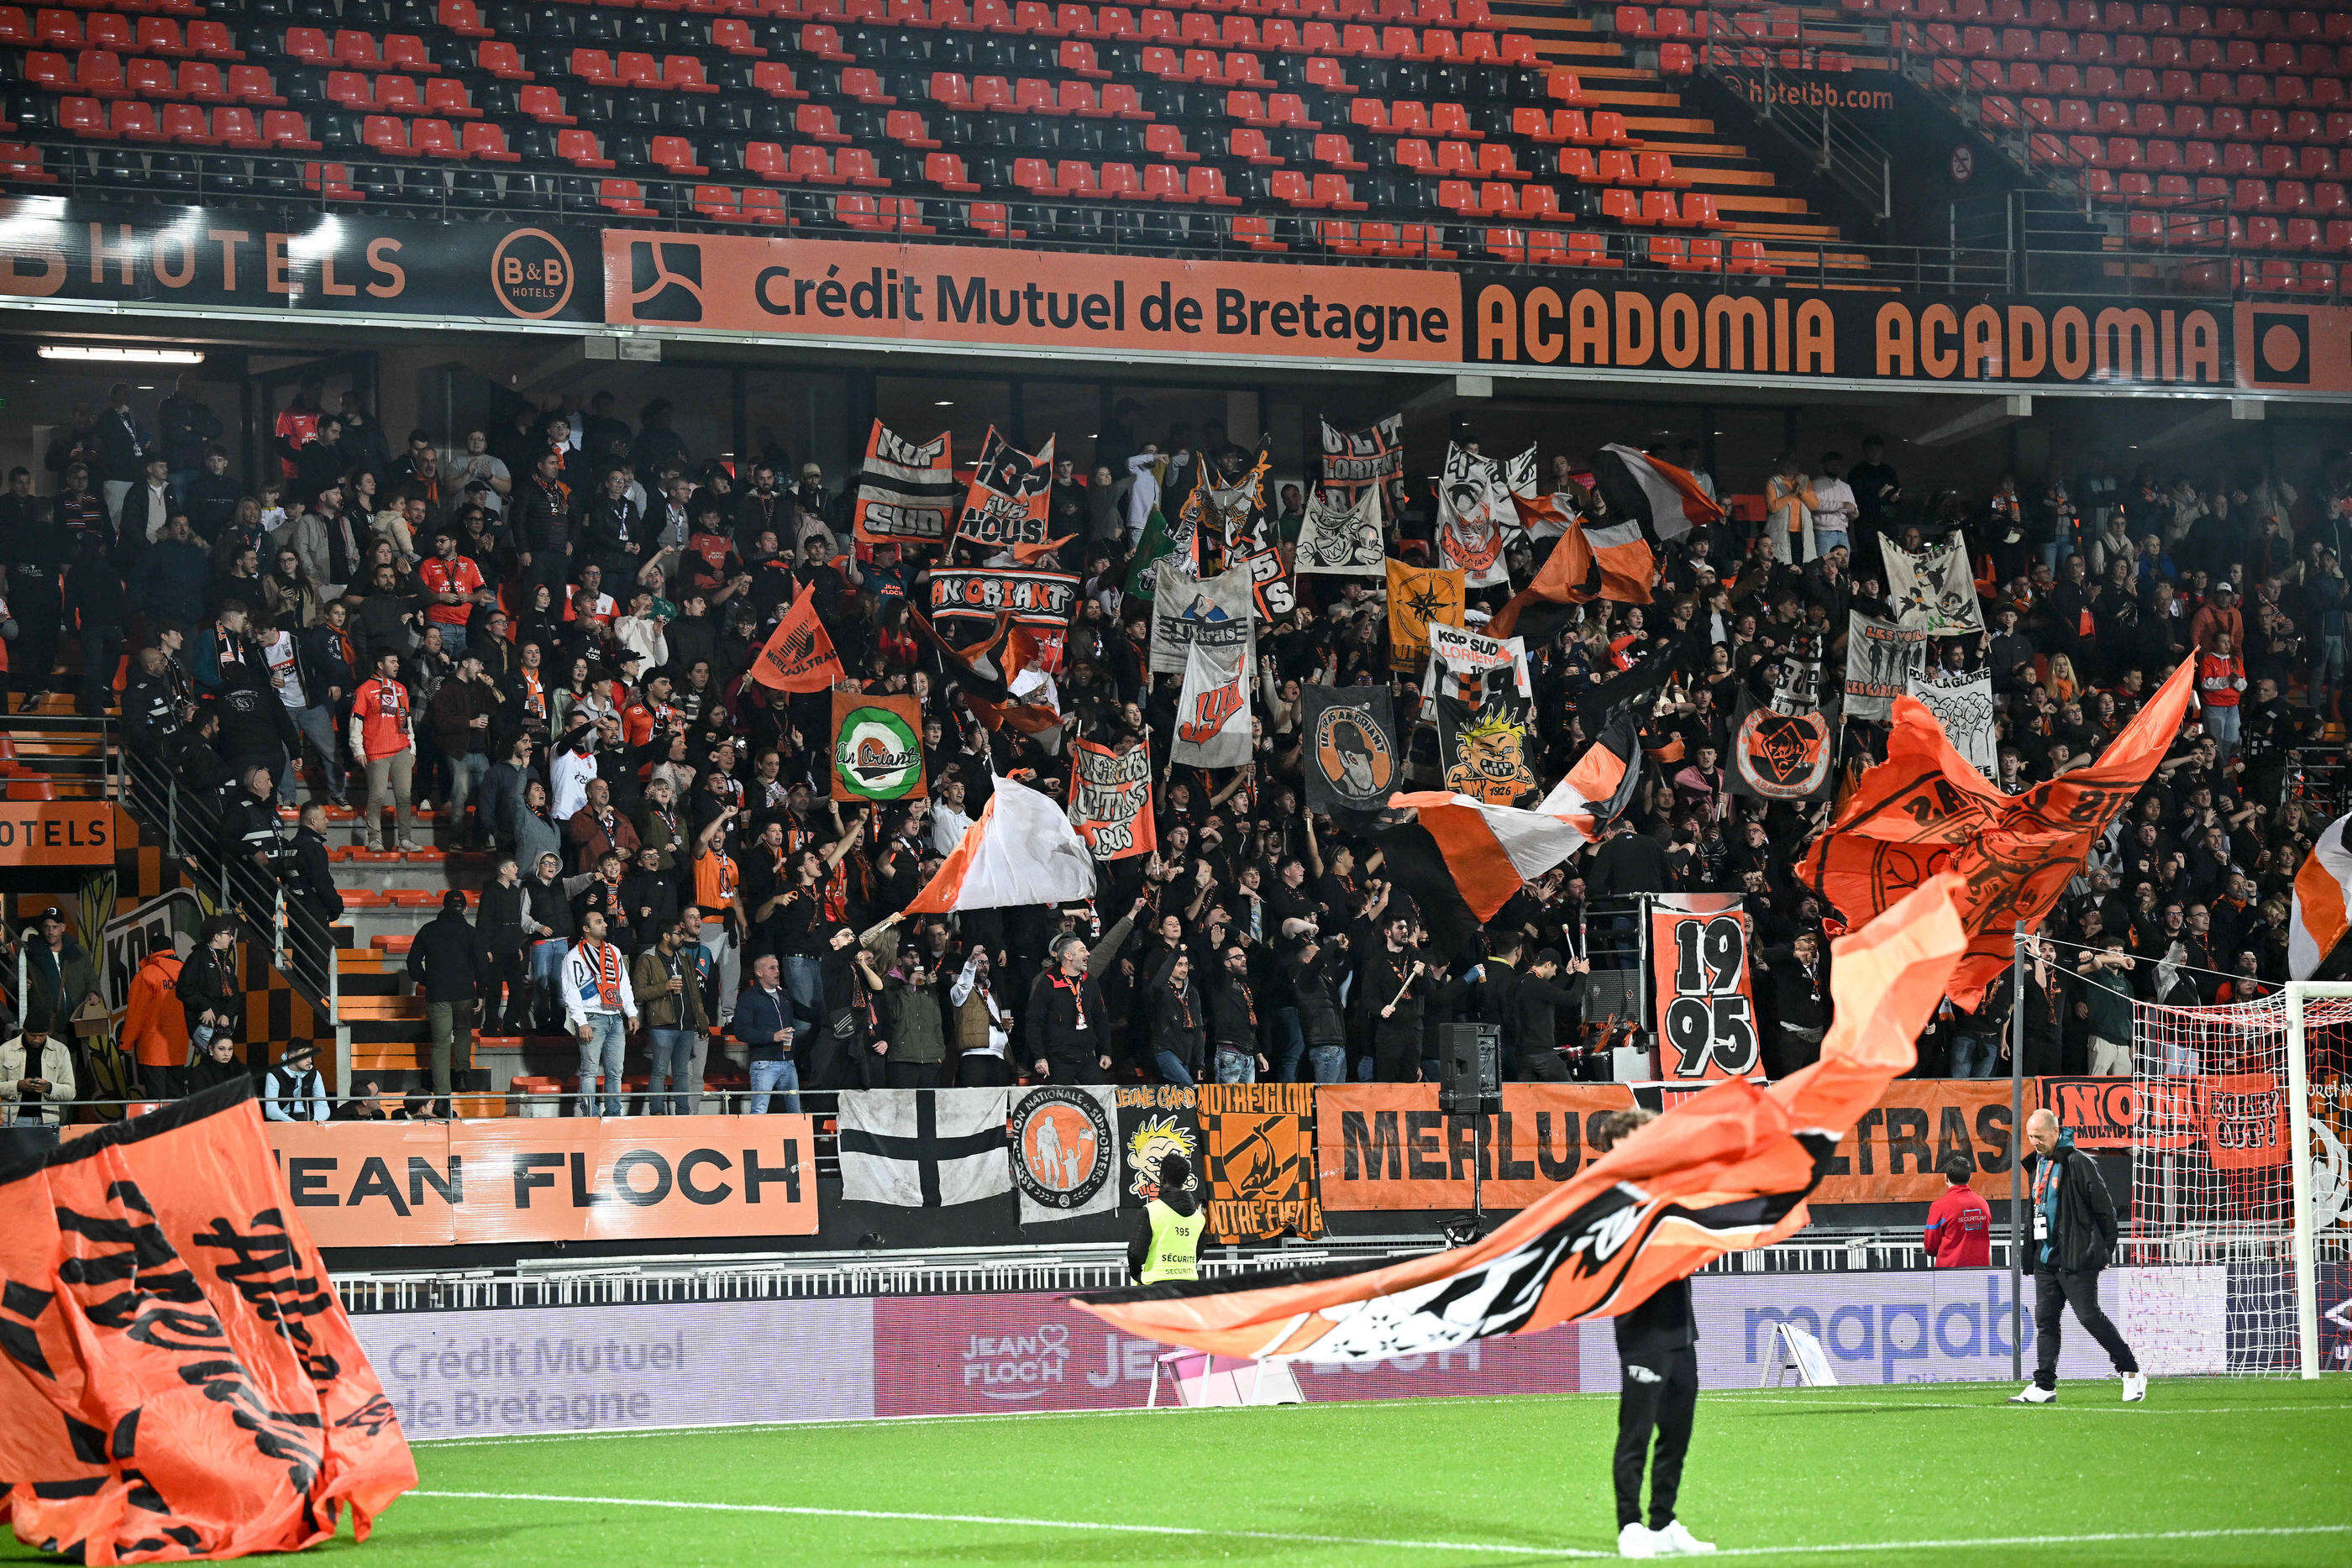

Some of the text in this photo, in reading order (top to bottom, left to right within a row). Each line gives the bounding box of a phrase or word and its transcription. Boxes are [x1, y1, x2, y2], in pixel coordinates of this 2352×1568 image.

[90, 222, 406, 298] HOTELS
[504, 256, 564, 286] B&B
[512, 287, 555, 298] HOTELS
[755, 265, 1448, 352] Crédit Mutuel de Bretagne
[1477, 285, 1835, 373] ACADOMIA
[1876, 301, 2218, 382] ACADOMIA
[864, 501, 946, 538] SUD
[932, 579, 1074, 613] AN ORIANT
[1438, 629, 1499, 656] KOP SUD
[1490, 787, 1512, 797] 1926
[1675, 916, 1745, 996] 19
[1665, 994, 1759, 1078] 95
[1157, 1085, 1196, 1110] GARD
[1024, 1088, 1086, 1111] NATIONALE
[1089, 1108, 1110, 1184] SUPPORTERS
[274, 1138, 801, 1217] EAN FLOCH
[389, 1333, 684, 1380] Crédit Mutuel
[963, 1334, 1037, 1359] JEAN
[964, 1357, 1063, 1386] FLOCH
[456, 1387, 651, 1430] Bretagne
